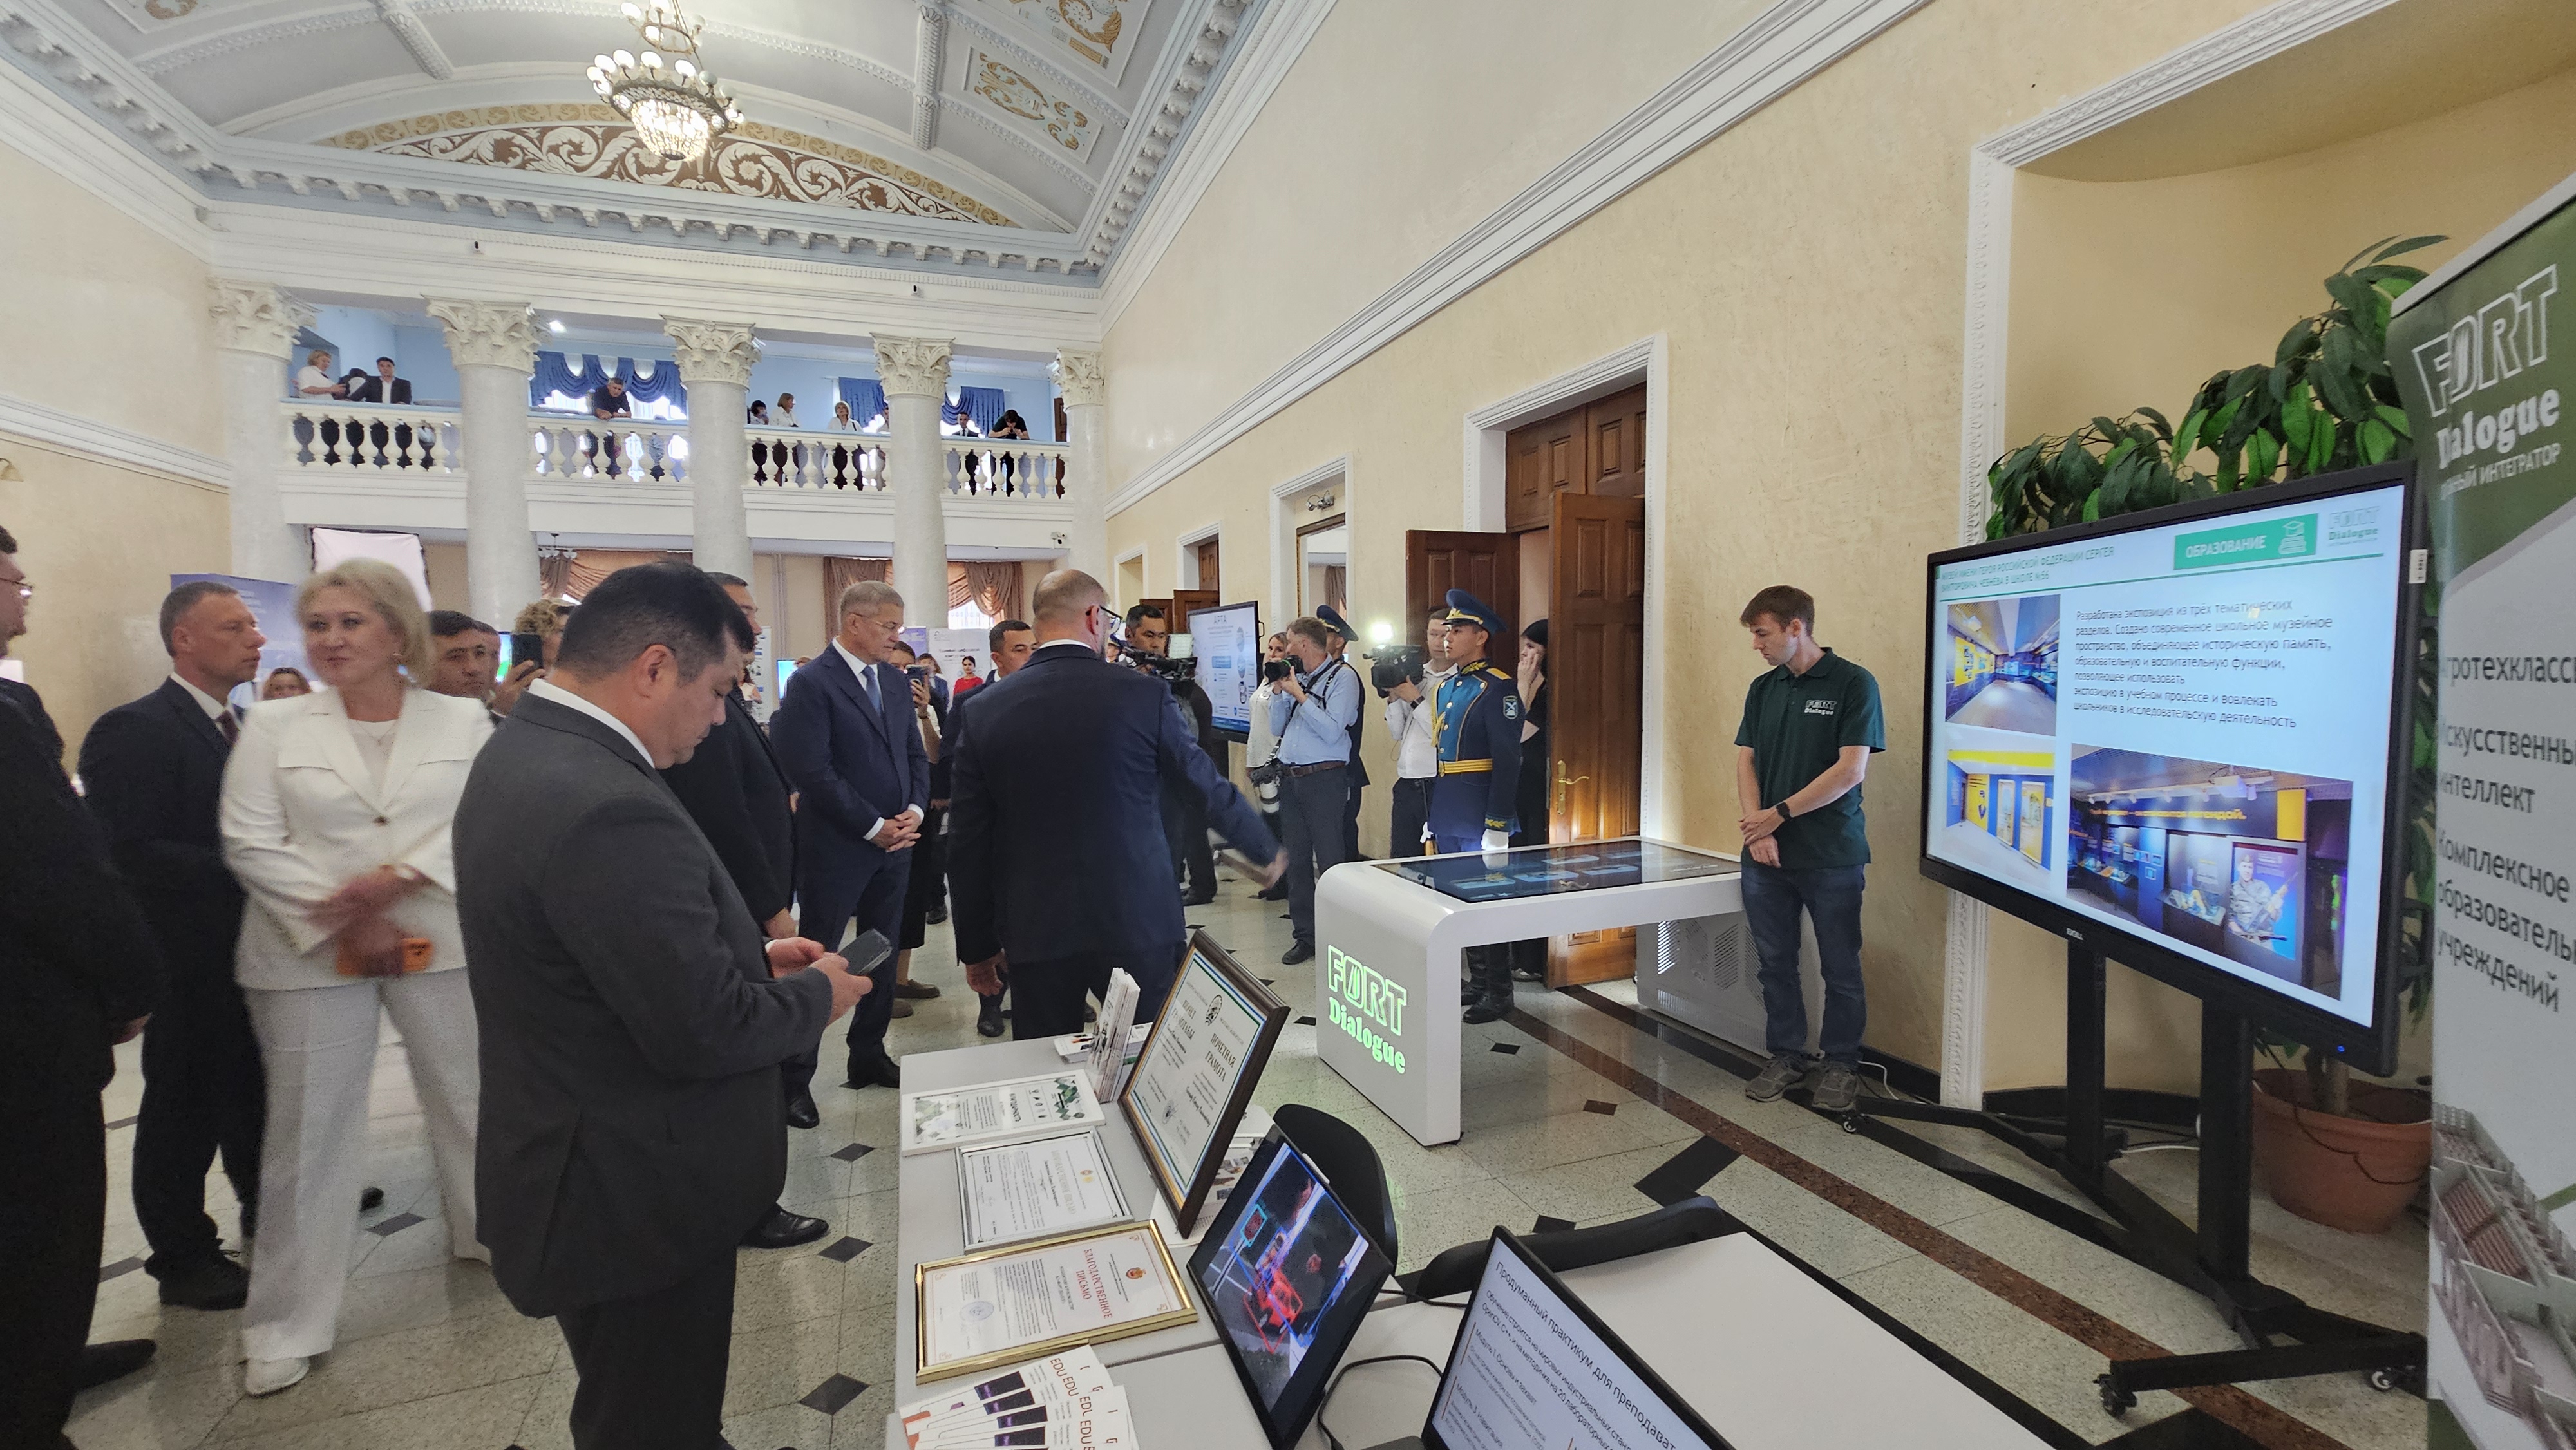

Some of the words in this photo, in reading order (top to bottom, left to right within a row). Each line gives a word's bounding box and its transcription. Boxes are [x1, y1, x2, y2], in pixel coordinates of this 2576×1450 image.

[2411, 263, 2559, 419] FORT
[2329, 529, 2378, 540] Dialogue
[2186, 535, 2267, 558] ОБРАЗОВАНИЕ
[2076, 610, 2122, 621] Разработана
[2125, 607, 2174, 619] экспозиция
[2176, 607, 2187, 616] из
[2116, 624, 2148, 636] Создано
[2151, 623, 2212, 635] современное
[2215, 620, 2269, 632] школьное
[2273, 615, 2333, 632] музейное
[2202, 640, 2279, 652] историческую
[2283, 639, 2331, 651] память,
[2075, 656, 2141, 668] образовательную
[2152, 658, 2229, 670] воспитательную
[2231, 656, 2286, 670] функции,
[2448, 656, 2576, 687] ротехкласс
[2127, 674, 2185, 684] использовать
[1805, 699, 1837, 710] FORT
[2126, 688, 2162, 700] учебном
[2165, 692, 2209, 703] процессе
[2211, 695, 2218, 703] и
[2222, 695, 2278, 706] вовлекать
[2126, 706, 2216, 723] исследовательскую
[2219, 713, 2297, 728] деятельность
[2439, 878, 2576, 965] образователь
[1328, 945, 1407, 1037] FORT
[1329, 997, 1406, 1074] Dialogue
[1210, 1032, 1236, 1068] ПОЧЕТНАЯ
[1205, 1050, 1227, 1082] ГРАМОТА
[1075, 1270, 1092, 1300] ПИСЬМО
[1083, 1248, 1113, 1319] БЛАГОДАРСТВЕННОЕ
[1495, 1261, 1548, 1322] Продуманный
[1548, 1319, 1594, 1370] практикум
[1592, 1367, 1613, 1390] для
[1050, 1357, 1068, 1377] EDU
[1063, 1376, 1079, 1397] EDU
[1557, 1389, 1566, 1402] 20
[1562, 1374, 1611, 1432] индустриальных
[1080, 1420, 1092, 1444] EDU
